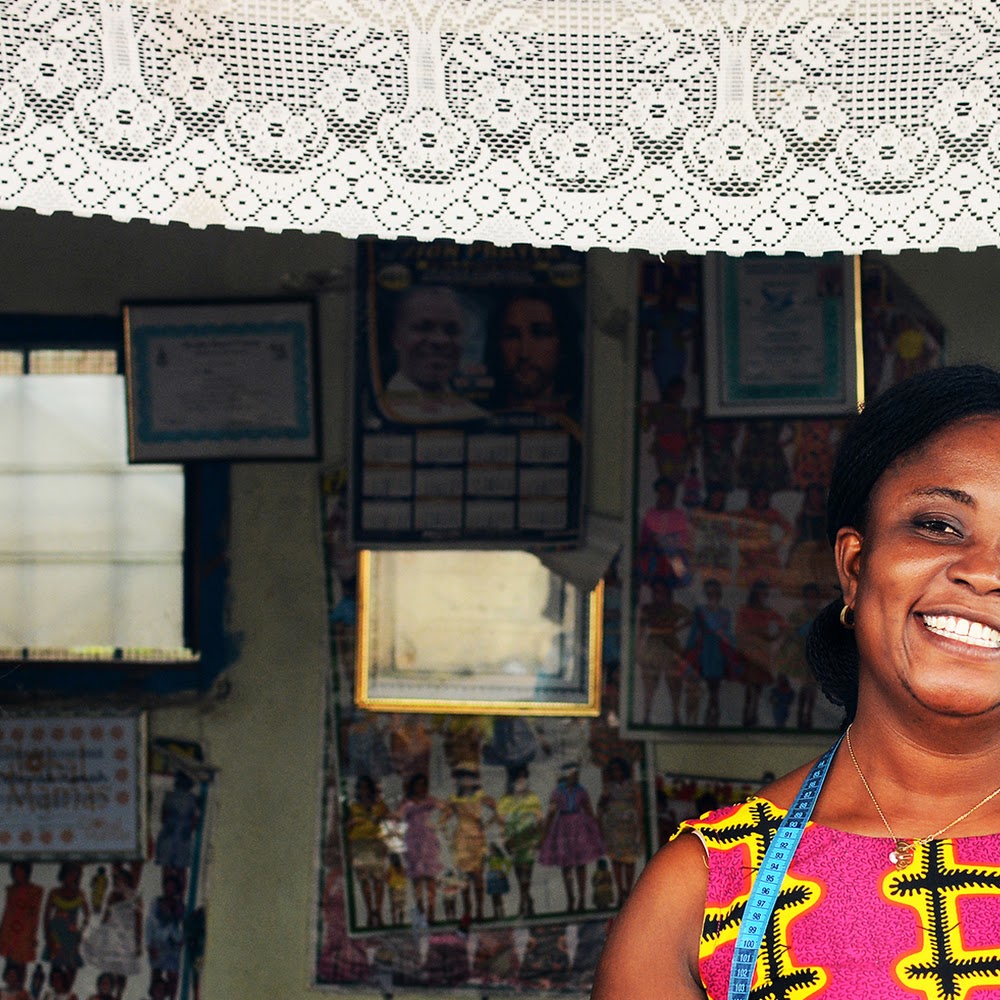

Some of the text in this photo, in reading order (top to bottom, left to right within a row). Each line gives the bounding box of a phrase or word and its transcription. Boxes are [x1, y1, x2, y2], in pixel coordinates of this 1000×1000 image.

[784, 831, 793, 839] 91
[765, 874, 775, 883] 95
[761, 887, 771, 895] 96
[757, 899, 766, 907] 97
[752, 912, 761, 921] 98
[748, 925, 757, 934] 99
[743, 940, 755, 948] 100
[740, 954, 751, 962] 101
[737, 969, 748, 978] 102
[735, 984, 746, 992] 103
